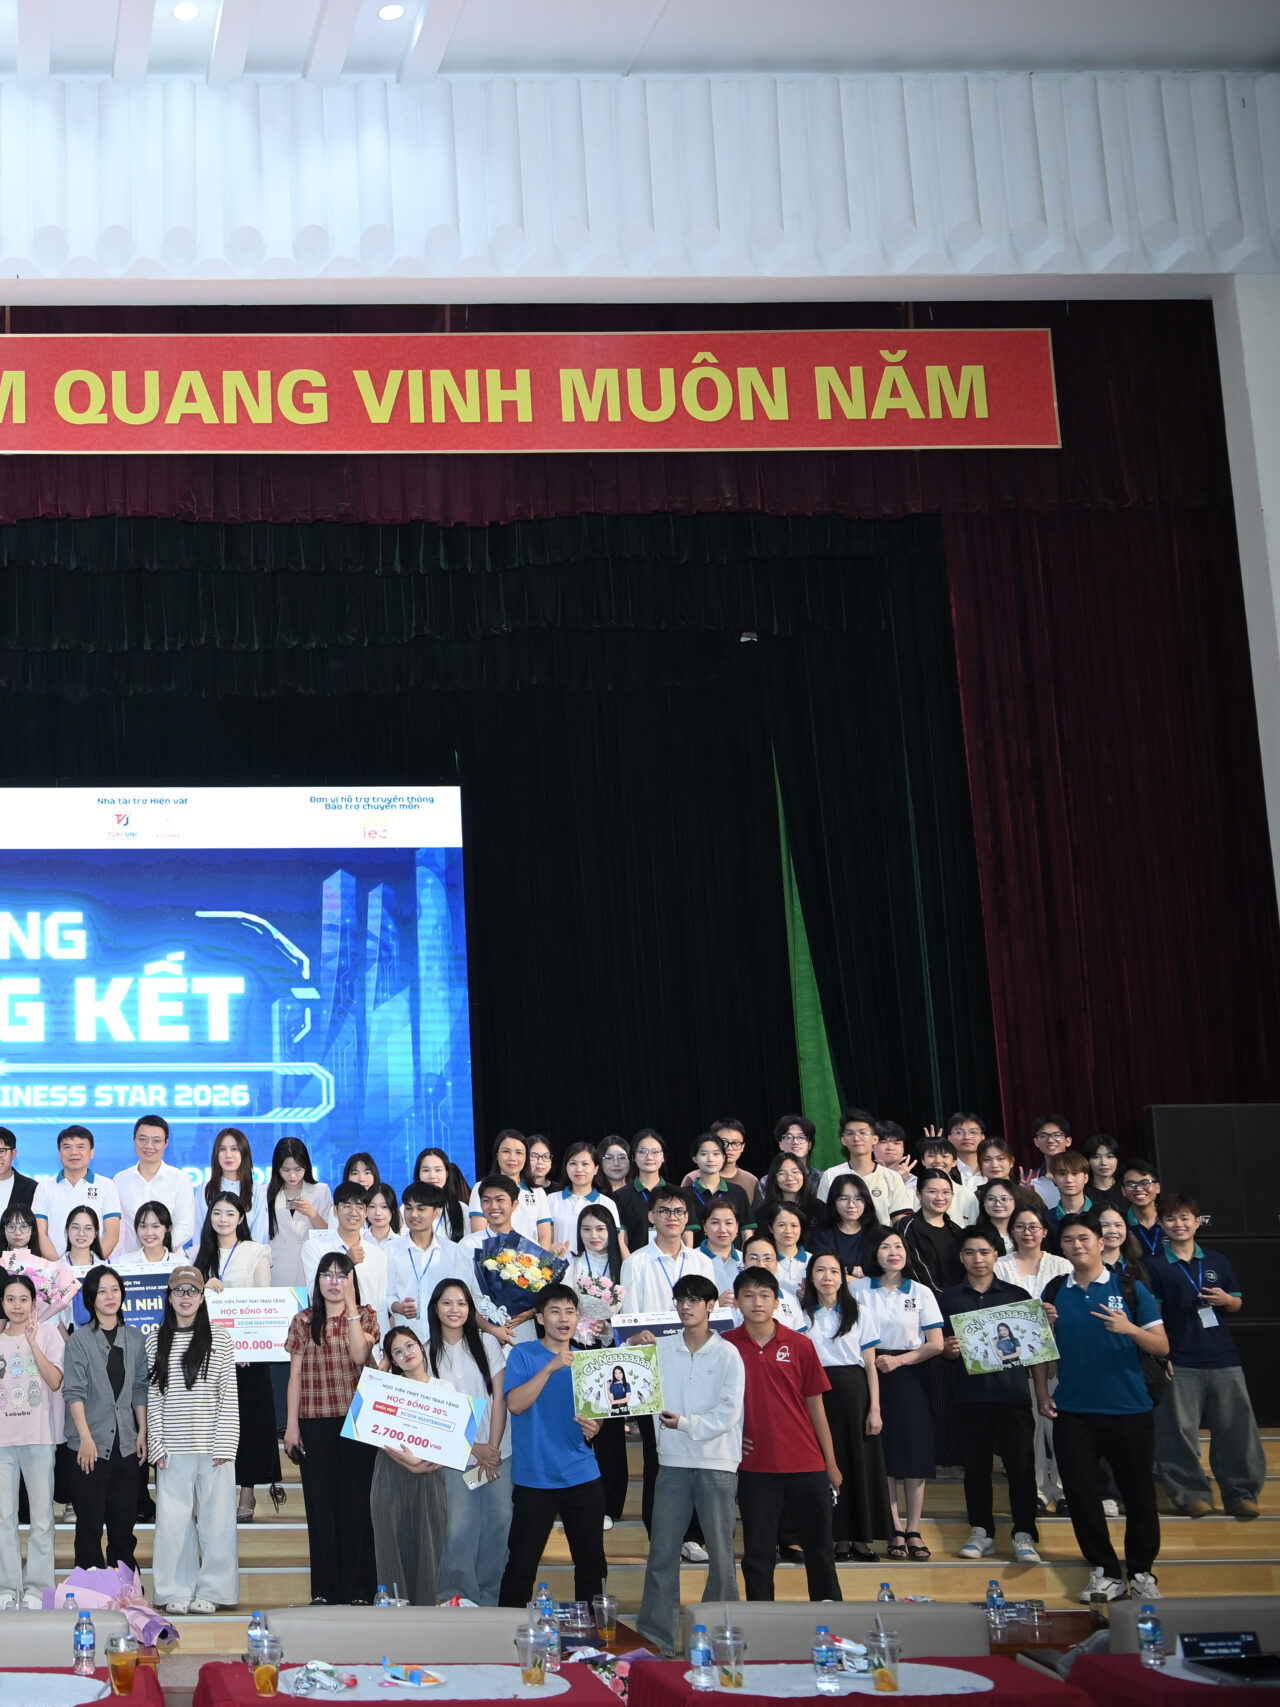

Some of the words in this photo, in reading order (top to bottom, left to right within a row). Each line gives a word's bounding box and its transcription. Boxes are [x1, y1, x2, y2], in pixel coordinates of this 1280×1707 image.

[53, 368, 327, 426] QUANG
[353, 367, 532, 424] VINH
[558, 351, 790, 423] MUÔN
[814, 349, 989, 421] NĂM
[75, 951, 246, 1042] KẾT
[94, 1084, 167, 1107] STAR
[174, 1084, 250, 1106] 2026
[136, 1295, 163, 1311] NHÌ
[220, 1308, 238, 1316] HỌC
[387, 1395, 405, 1405] HỌC
[407, 1398, 430, 1411] BỔNG
[433, 1407, 448, 1416] 30%
[371, 1424, 430, 1448] 2.700.000
